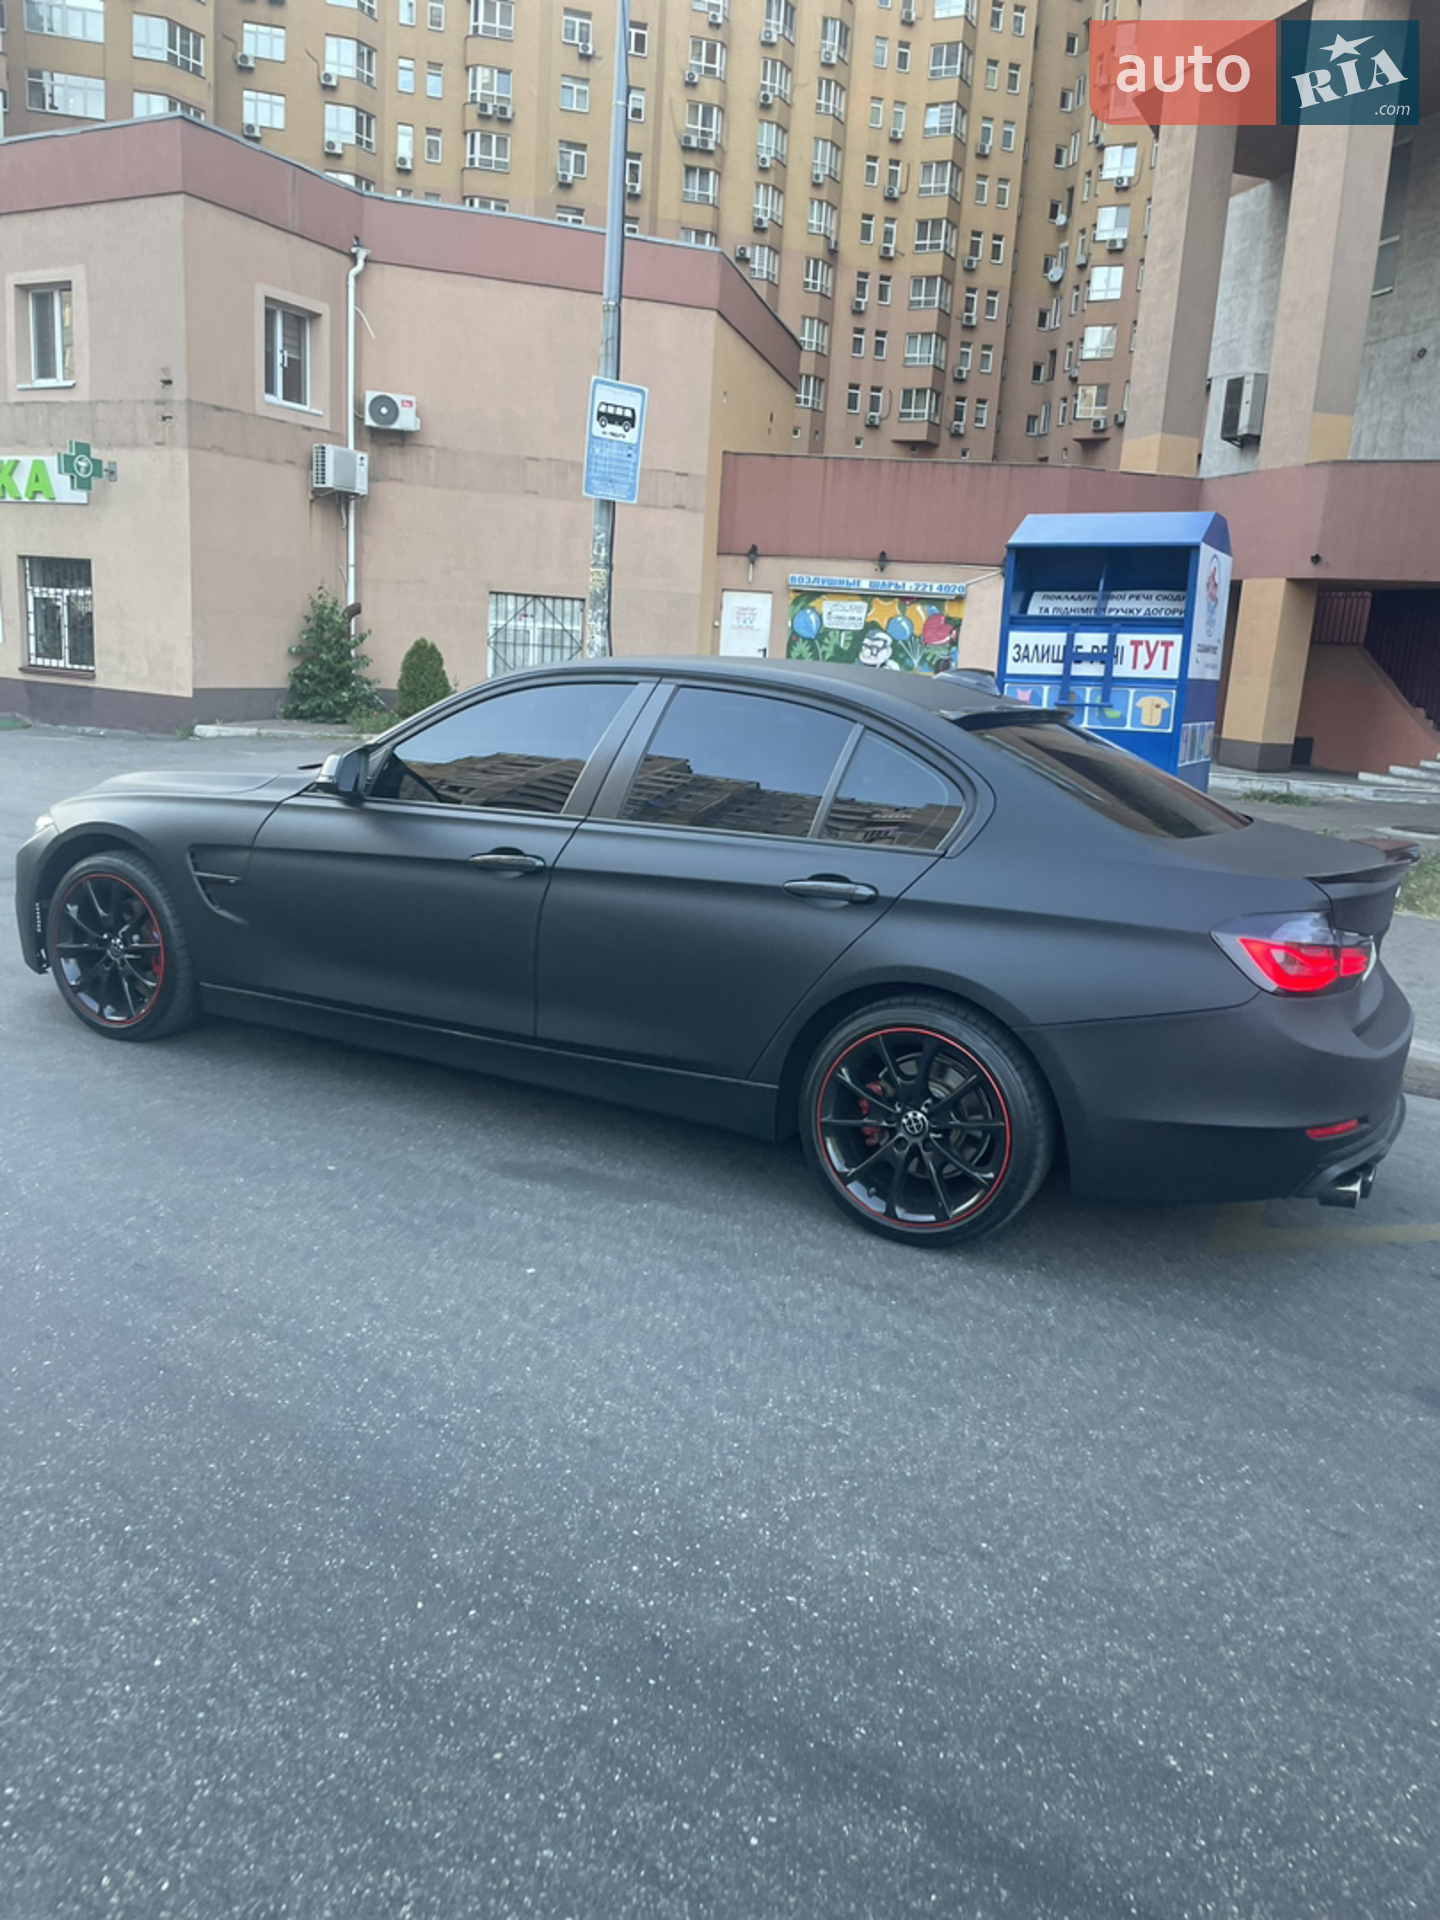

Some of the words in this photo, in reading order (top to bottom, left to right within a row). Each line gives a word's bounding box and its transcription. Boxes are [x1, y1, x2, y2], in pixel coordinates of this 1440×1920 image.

[790, 575, 861, 588] ВОЗДУШНЫЕ
[868, 580, 906, 591] ШАРЫ
[936, 584, 965, 594] 4020
[1128, 593, 1153, 601] РЕЧІ
[1038, 606, 1050, 614] ТА
[1052, 606, 1104, 615] ПІДНІМІТ
[1107, 607, 1143, 615] РУЧКУ
[1012, 643, 1083, 664] ЗАЛИШЕ
[1129, 640, 1174, 671] ТУТ
